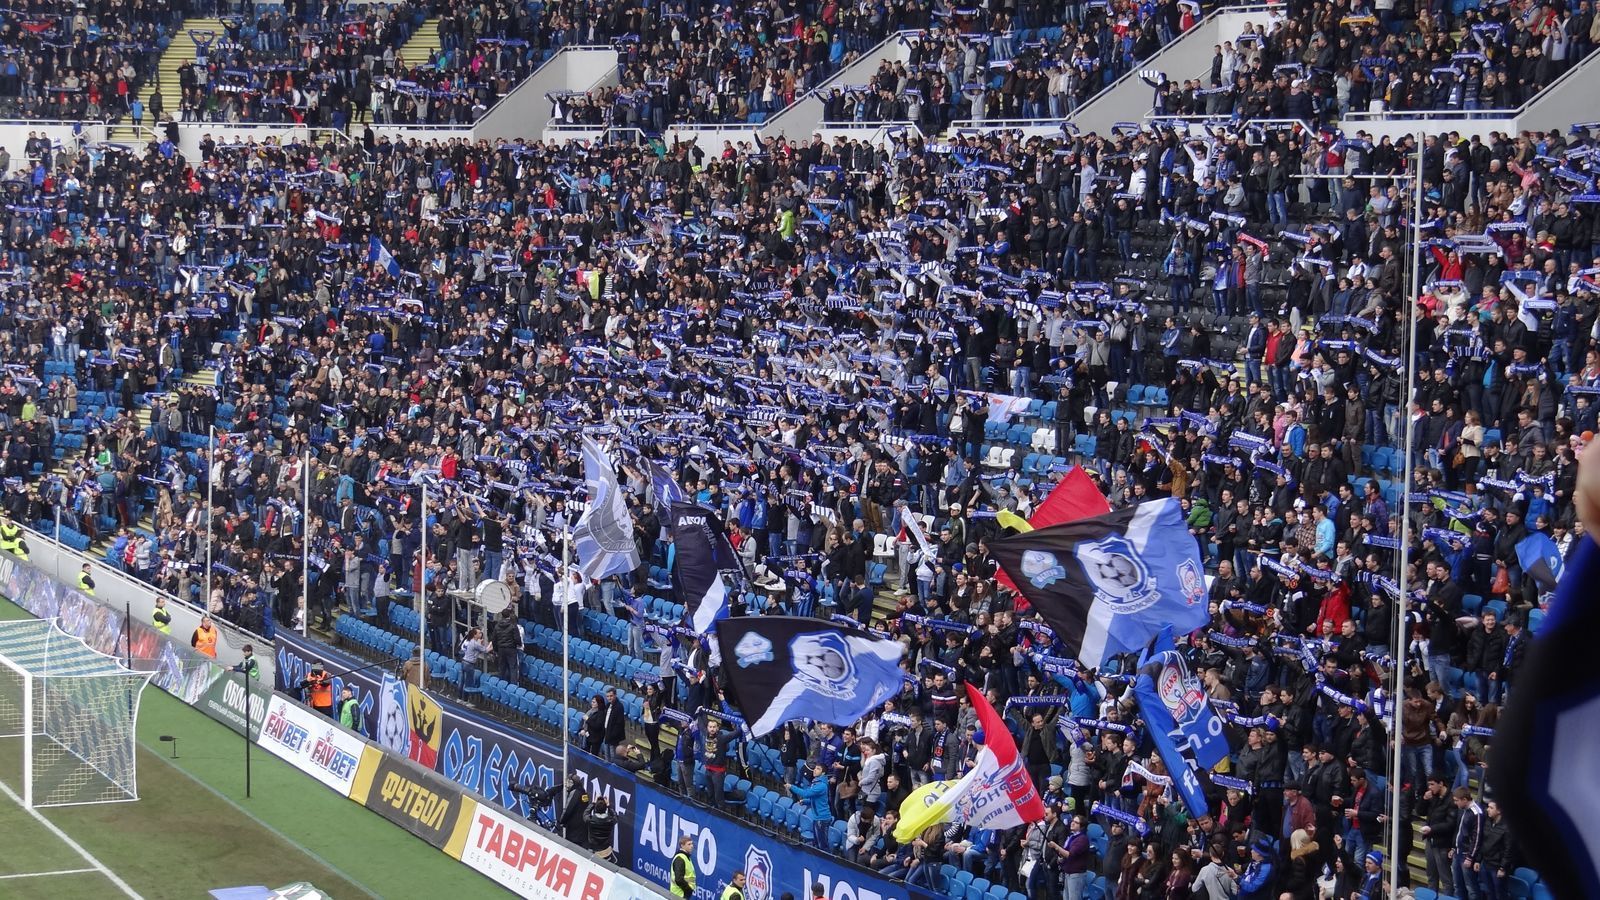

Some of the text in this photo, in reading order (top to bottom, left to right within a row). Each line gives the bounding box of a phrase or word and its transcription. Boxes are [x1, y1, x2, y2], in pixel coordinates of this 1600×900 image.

[264, 712, 309, 753] FAVBET
[310, 737, 358, 782] FAVBET
[1080, 718, 1097, 726] AUTO
[1106, 721, 1126, 731] MOTO
[380, 771, 451, 832] ФУТБОЛ
[476, 813, 578, 899] ТАВРИЯ
[639, 802, 718, 876] AUTO
[750, 876, 766, 891] FANS
